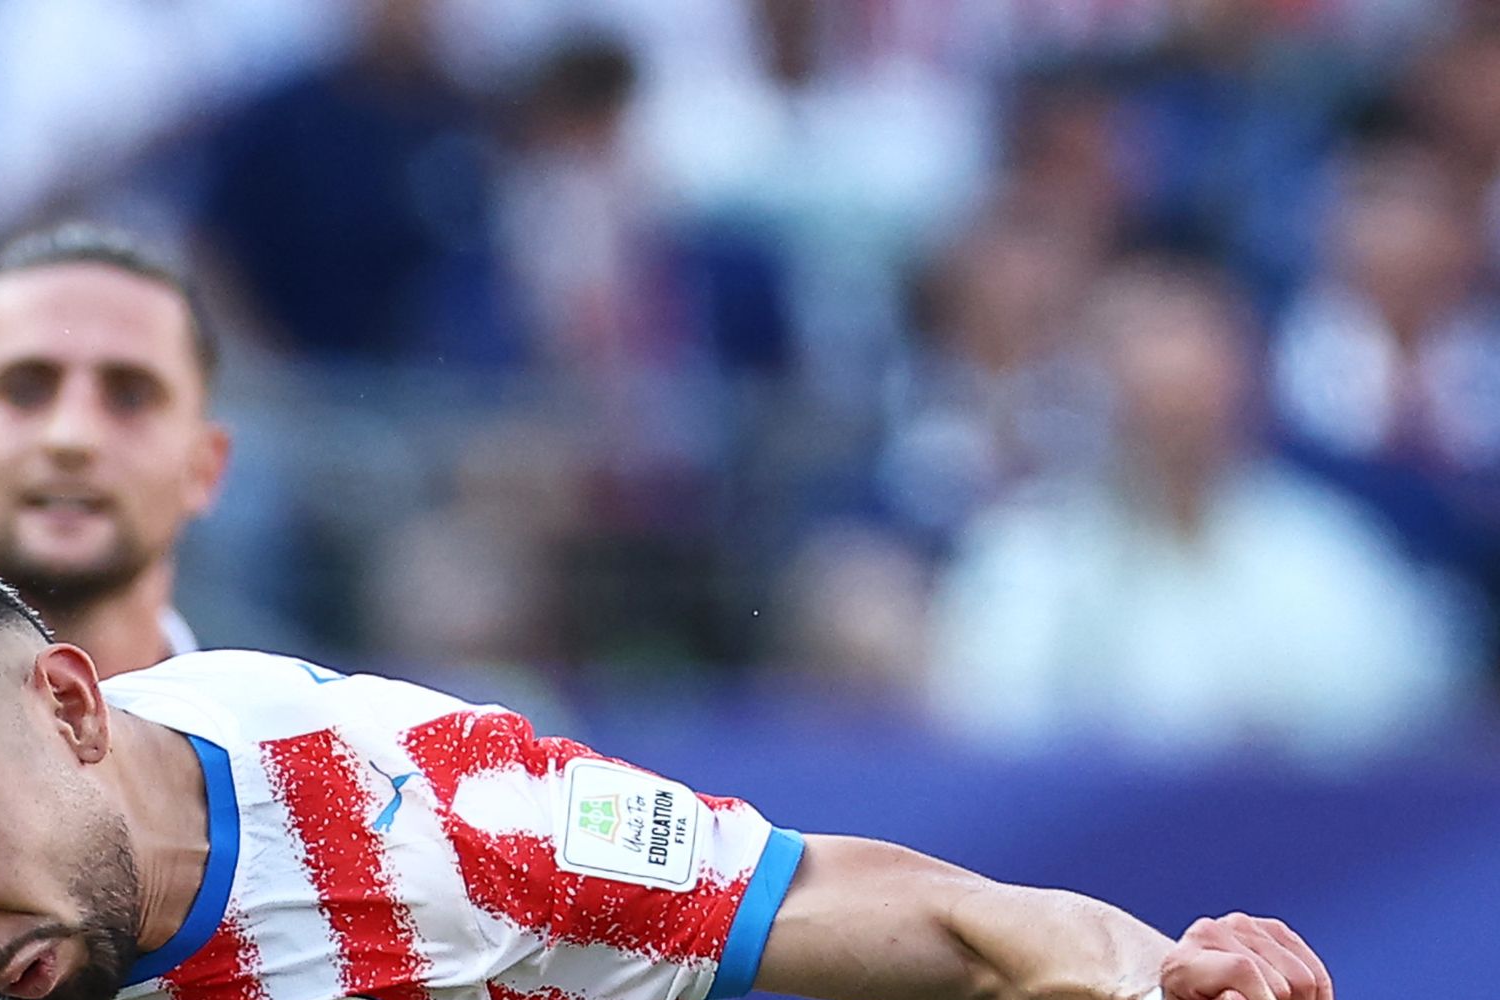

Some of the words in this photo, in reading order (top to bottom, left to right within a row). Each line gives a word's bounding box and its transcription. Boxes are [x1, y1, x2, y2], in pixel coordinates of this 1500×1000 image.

[622, 818, 646, 853] Unite
[648, 789, 674, 866] EDUCATION
[675, 817, 687, 844] FIFA
